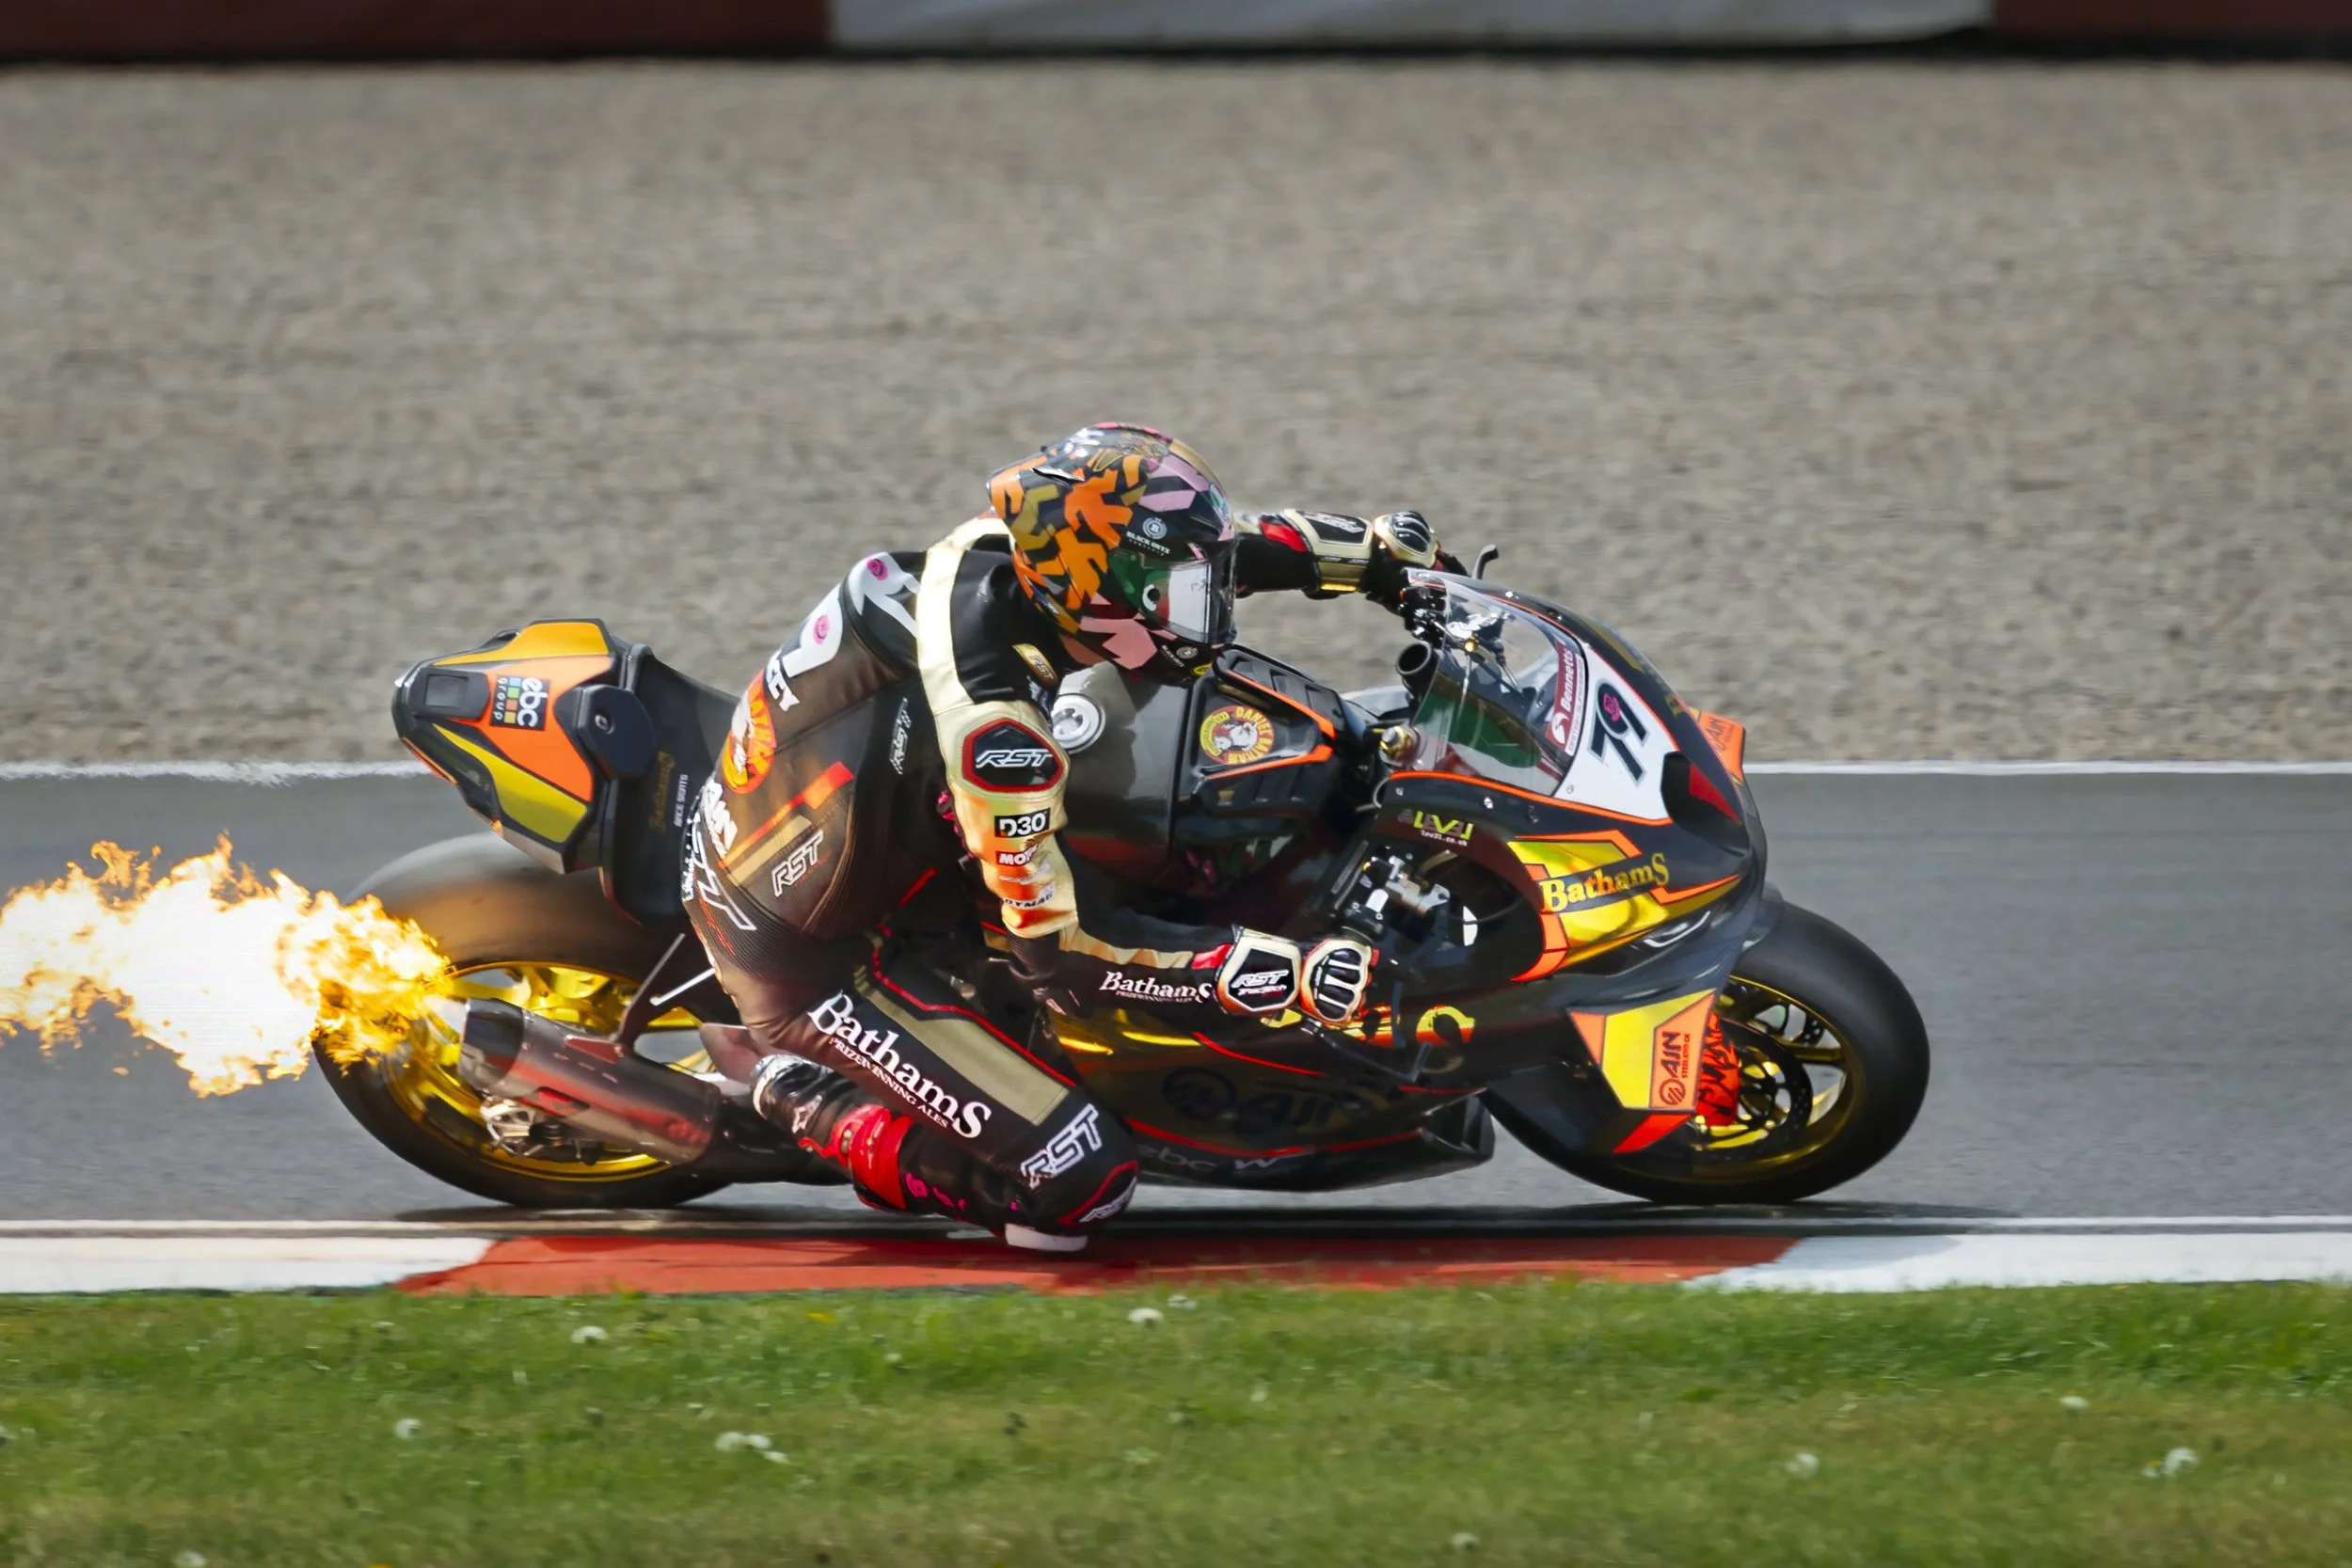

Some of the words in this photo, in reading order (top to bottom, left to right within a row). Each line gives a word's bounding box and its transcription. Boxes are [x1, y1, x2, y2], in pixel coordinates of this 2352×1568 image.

[492, 677, 508, 721] group
[516, 676, 548, 728] ebc
[1560, 648, 1575, 712] Bennetts
[975, 749, 1054, 768] RST
[1587, 678, 1650, 787] 79
[771, 829, 824, 897] RST
[1231, 969, 1290, 989] RST
[917, 1103, 949, 1129] ALES
[1021, 1102, 1103, 1190] RST
